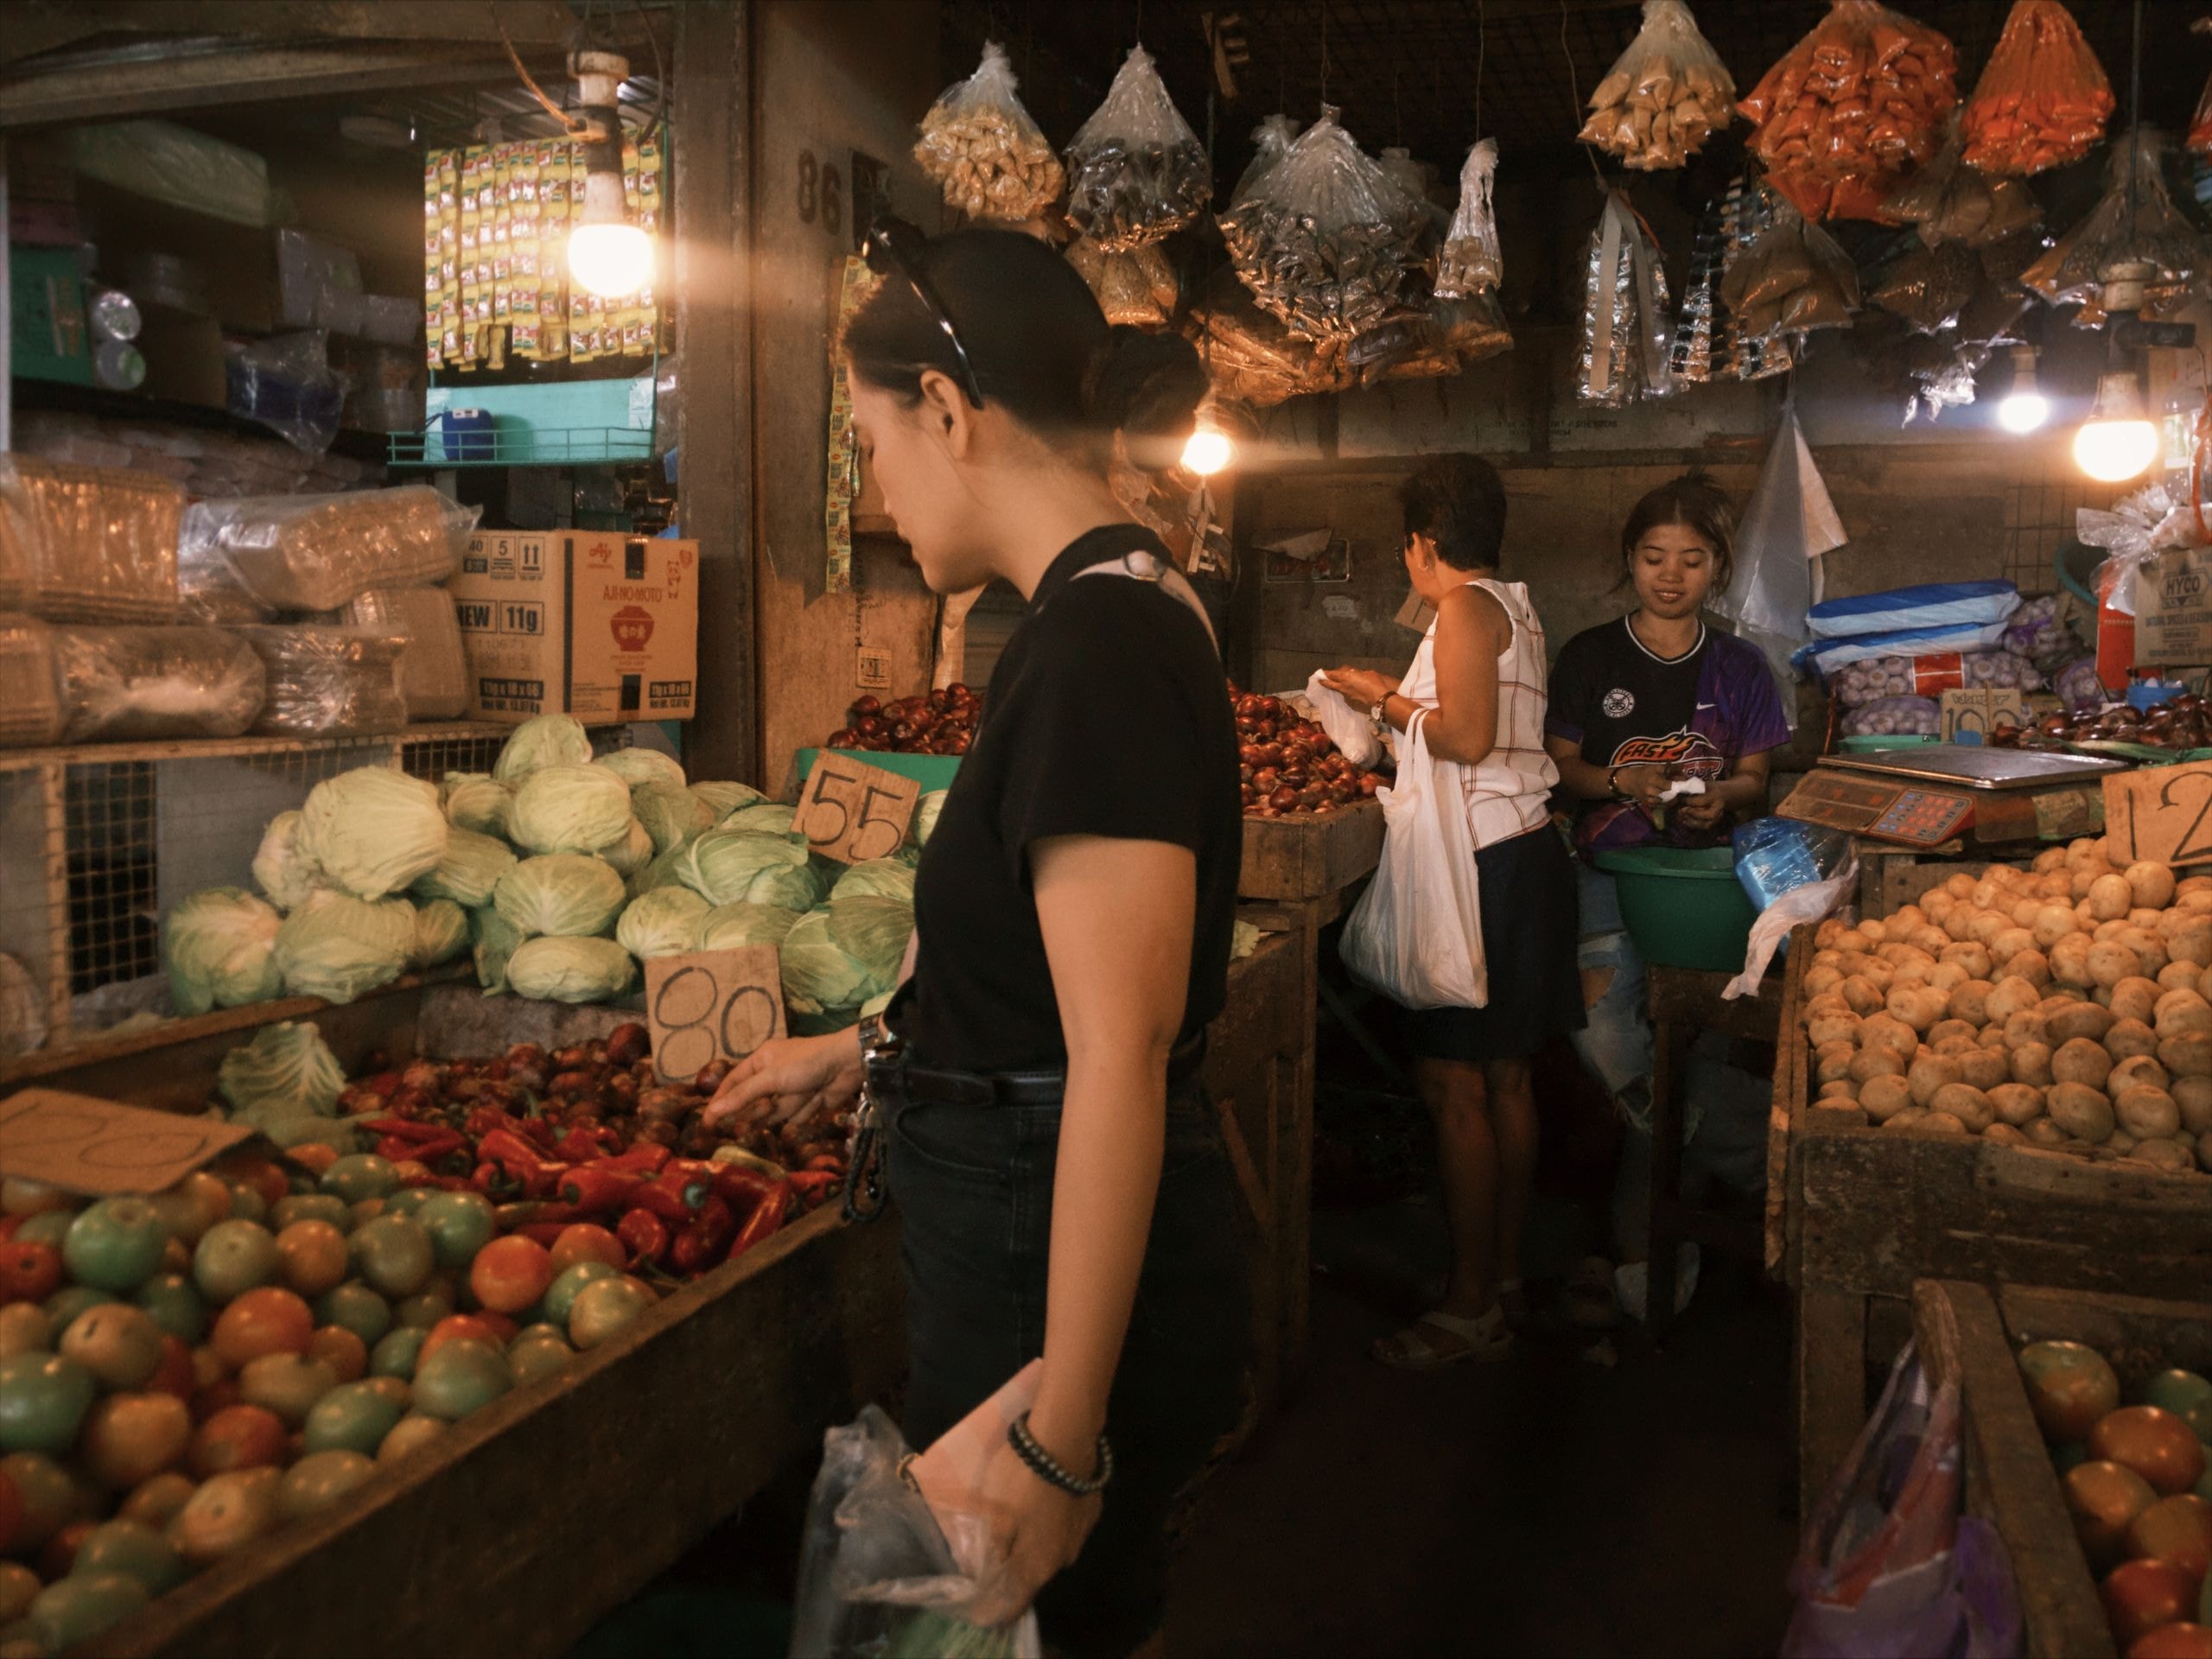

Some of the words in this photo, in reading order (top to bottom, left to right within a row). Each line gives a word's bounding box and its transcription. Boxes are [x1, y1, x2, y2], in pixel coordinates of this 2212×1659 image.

[798, 149, 842, 236] 86
[499, 540, 508, 556] 5
[2166, 576, 2200, 595] HYCO
[506, 606, 537, 632] 11g
[1621, 744, 1672, 761] FAST
[802, 769, 904, 861] 55
[654, 966, 778, 1082] 80
